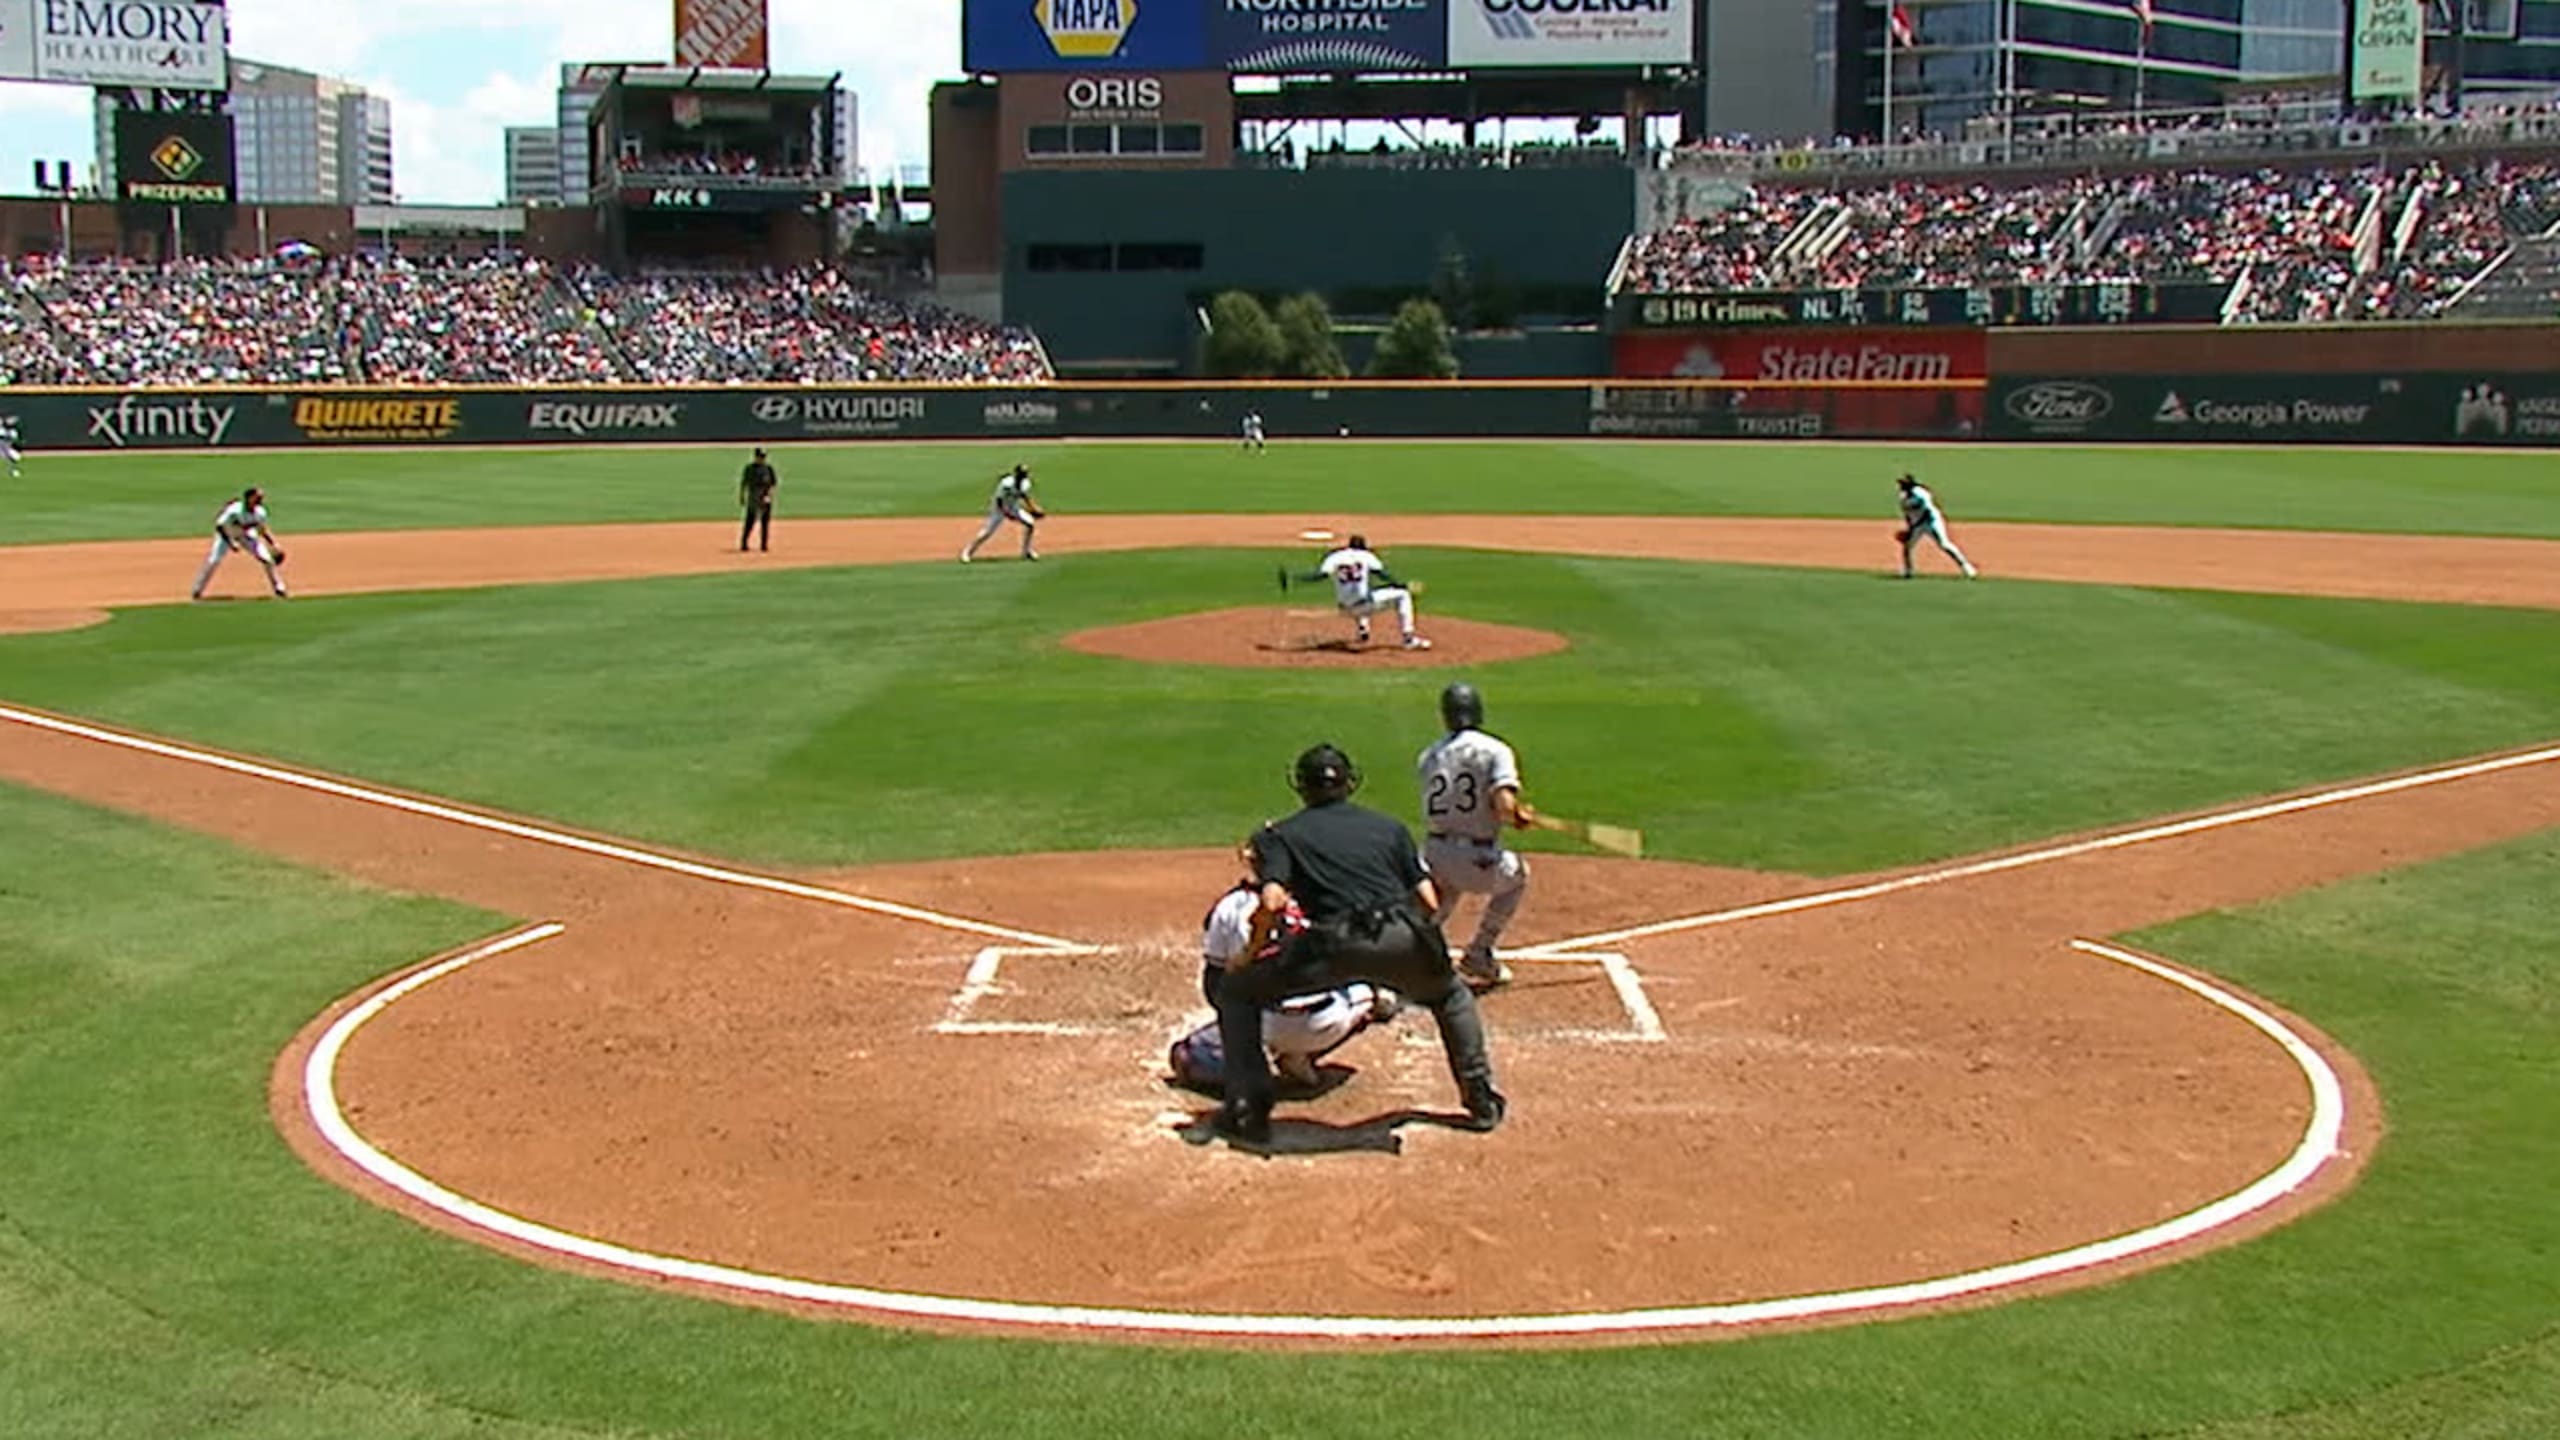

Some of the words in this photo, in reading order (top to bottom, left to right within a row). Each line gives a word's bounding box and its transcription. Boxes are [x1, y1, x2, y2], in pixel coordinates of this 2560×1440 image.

[46, 0, 212, 43] EMORY
[1053, 0, 1120, 29] NAPA
[1262, 13, 1390, 31] HOSPITAL
[46, 43, 207, 68] HEALTHCARE
[1069, 78, 1162, 108] ORIS
[1803, 299, 1832, 319] NL
[295, 397, 463, 429] QUIKRETE
[804, 397, 925, 419] HYUNDAI
[2023, 389, 2094, 418] Ford
[2194, 401, 2288, 428] Georgia
[2293, 401, 2369, 422] Power
[88, 396, 235, 446] xfinity
[530, 402, 679, 435] EQUIFAX
[1428, 772, 1477, 815] 23
